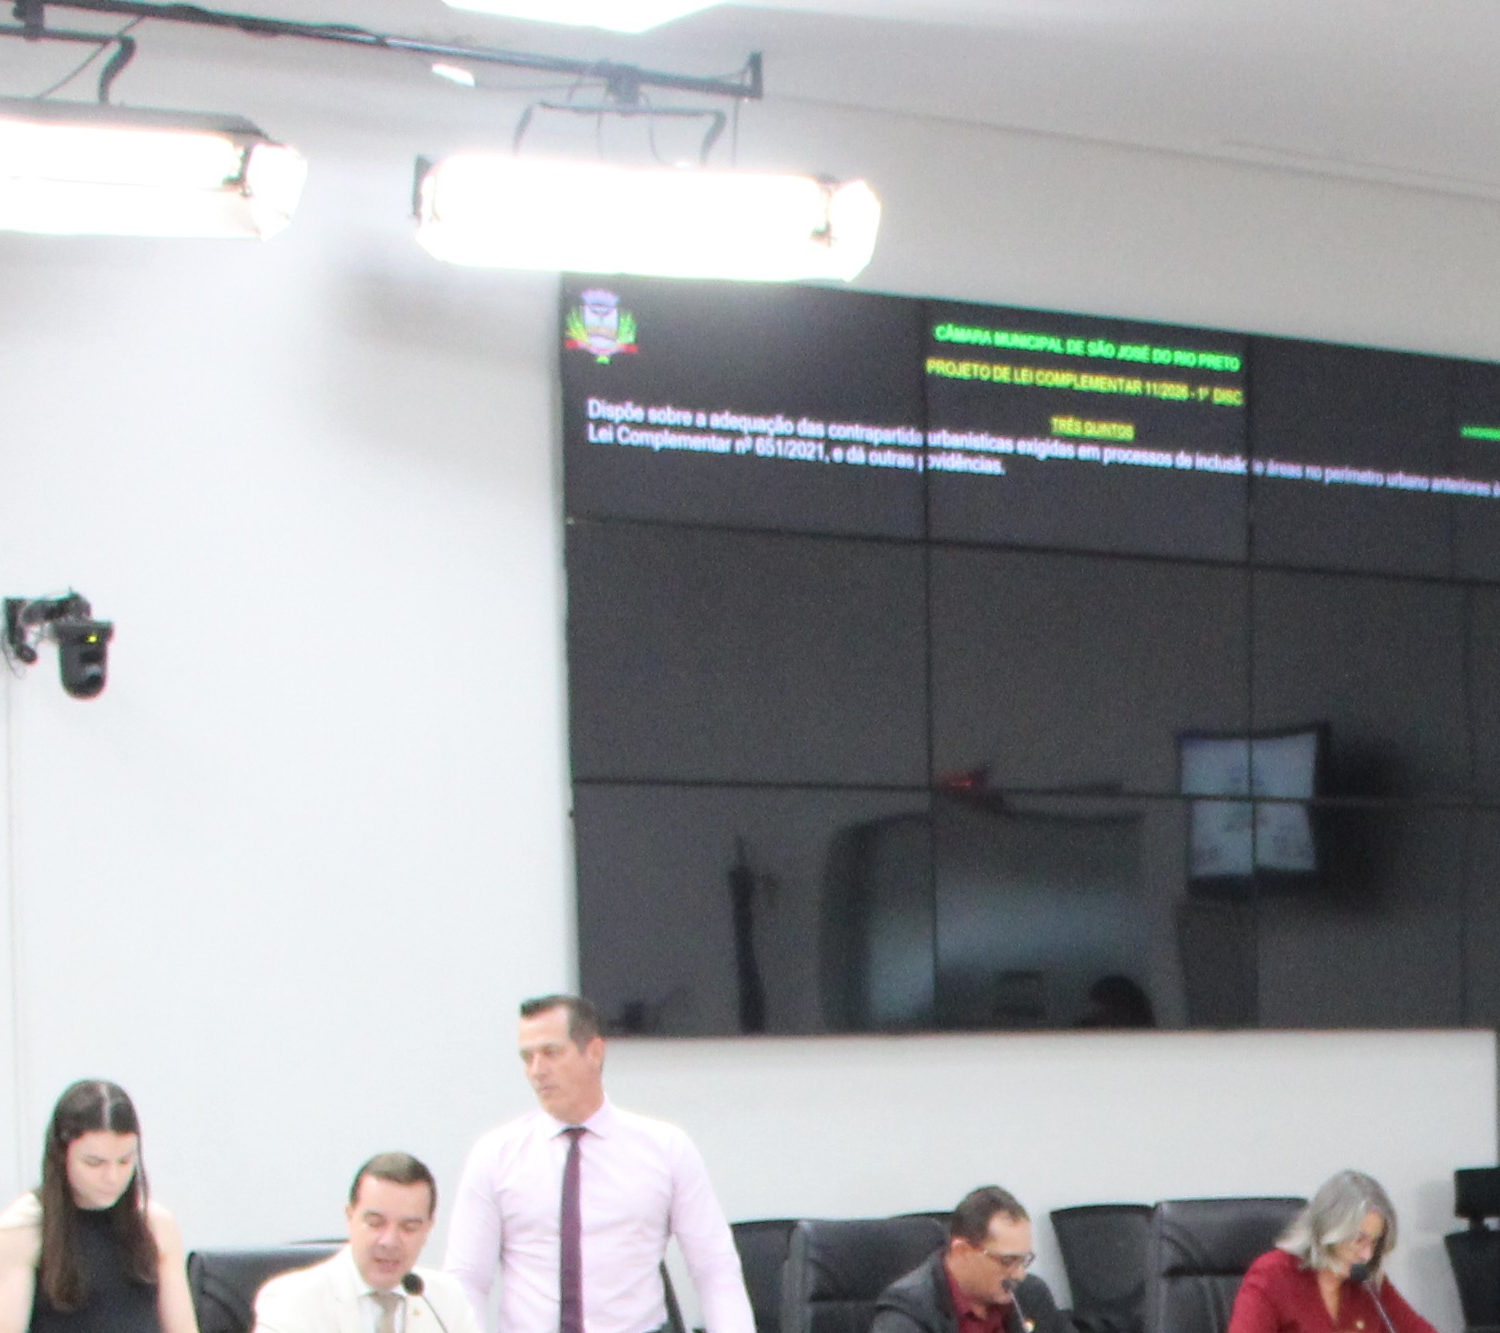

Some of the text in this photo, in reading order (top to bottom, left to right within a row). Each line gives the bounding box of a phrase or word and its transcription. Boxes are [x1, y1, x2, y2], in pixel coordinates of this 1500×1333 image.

[934, 323, 1241, 372] CÂMARA MUNICIPAL DE SÃO JOSÉ DO RIO PRETO
[926, 357, 990, 380] PROJETO
[993, 365, 1012, 382] DE
[1014, 367, 1034, 385] LEI
[1035, 369, 1142, 395] COMPLEMENTAR
[587, 398, 645, 425] Dispõe
[649, 406, 692, 427] sobre
[709, 410, 794, 437] adequação
[797, 416, 825, 439] das
[1017, 438, 1075, 461] exigidas
[1078, 445, 1100, 461] em
[1102, 446, 1172, 467] processos
[1175, 451, 1192, 469] de
[588, 422, 613, 445] Lei
[617, 426, 731, 453] Complementar
[869, 450, 915, 470] outras
